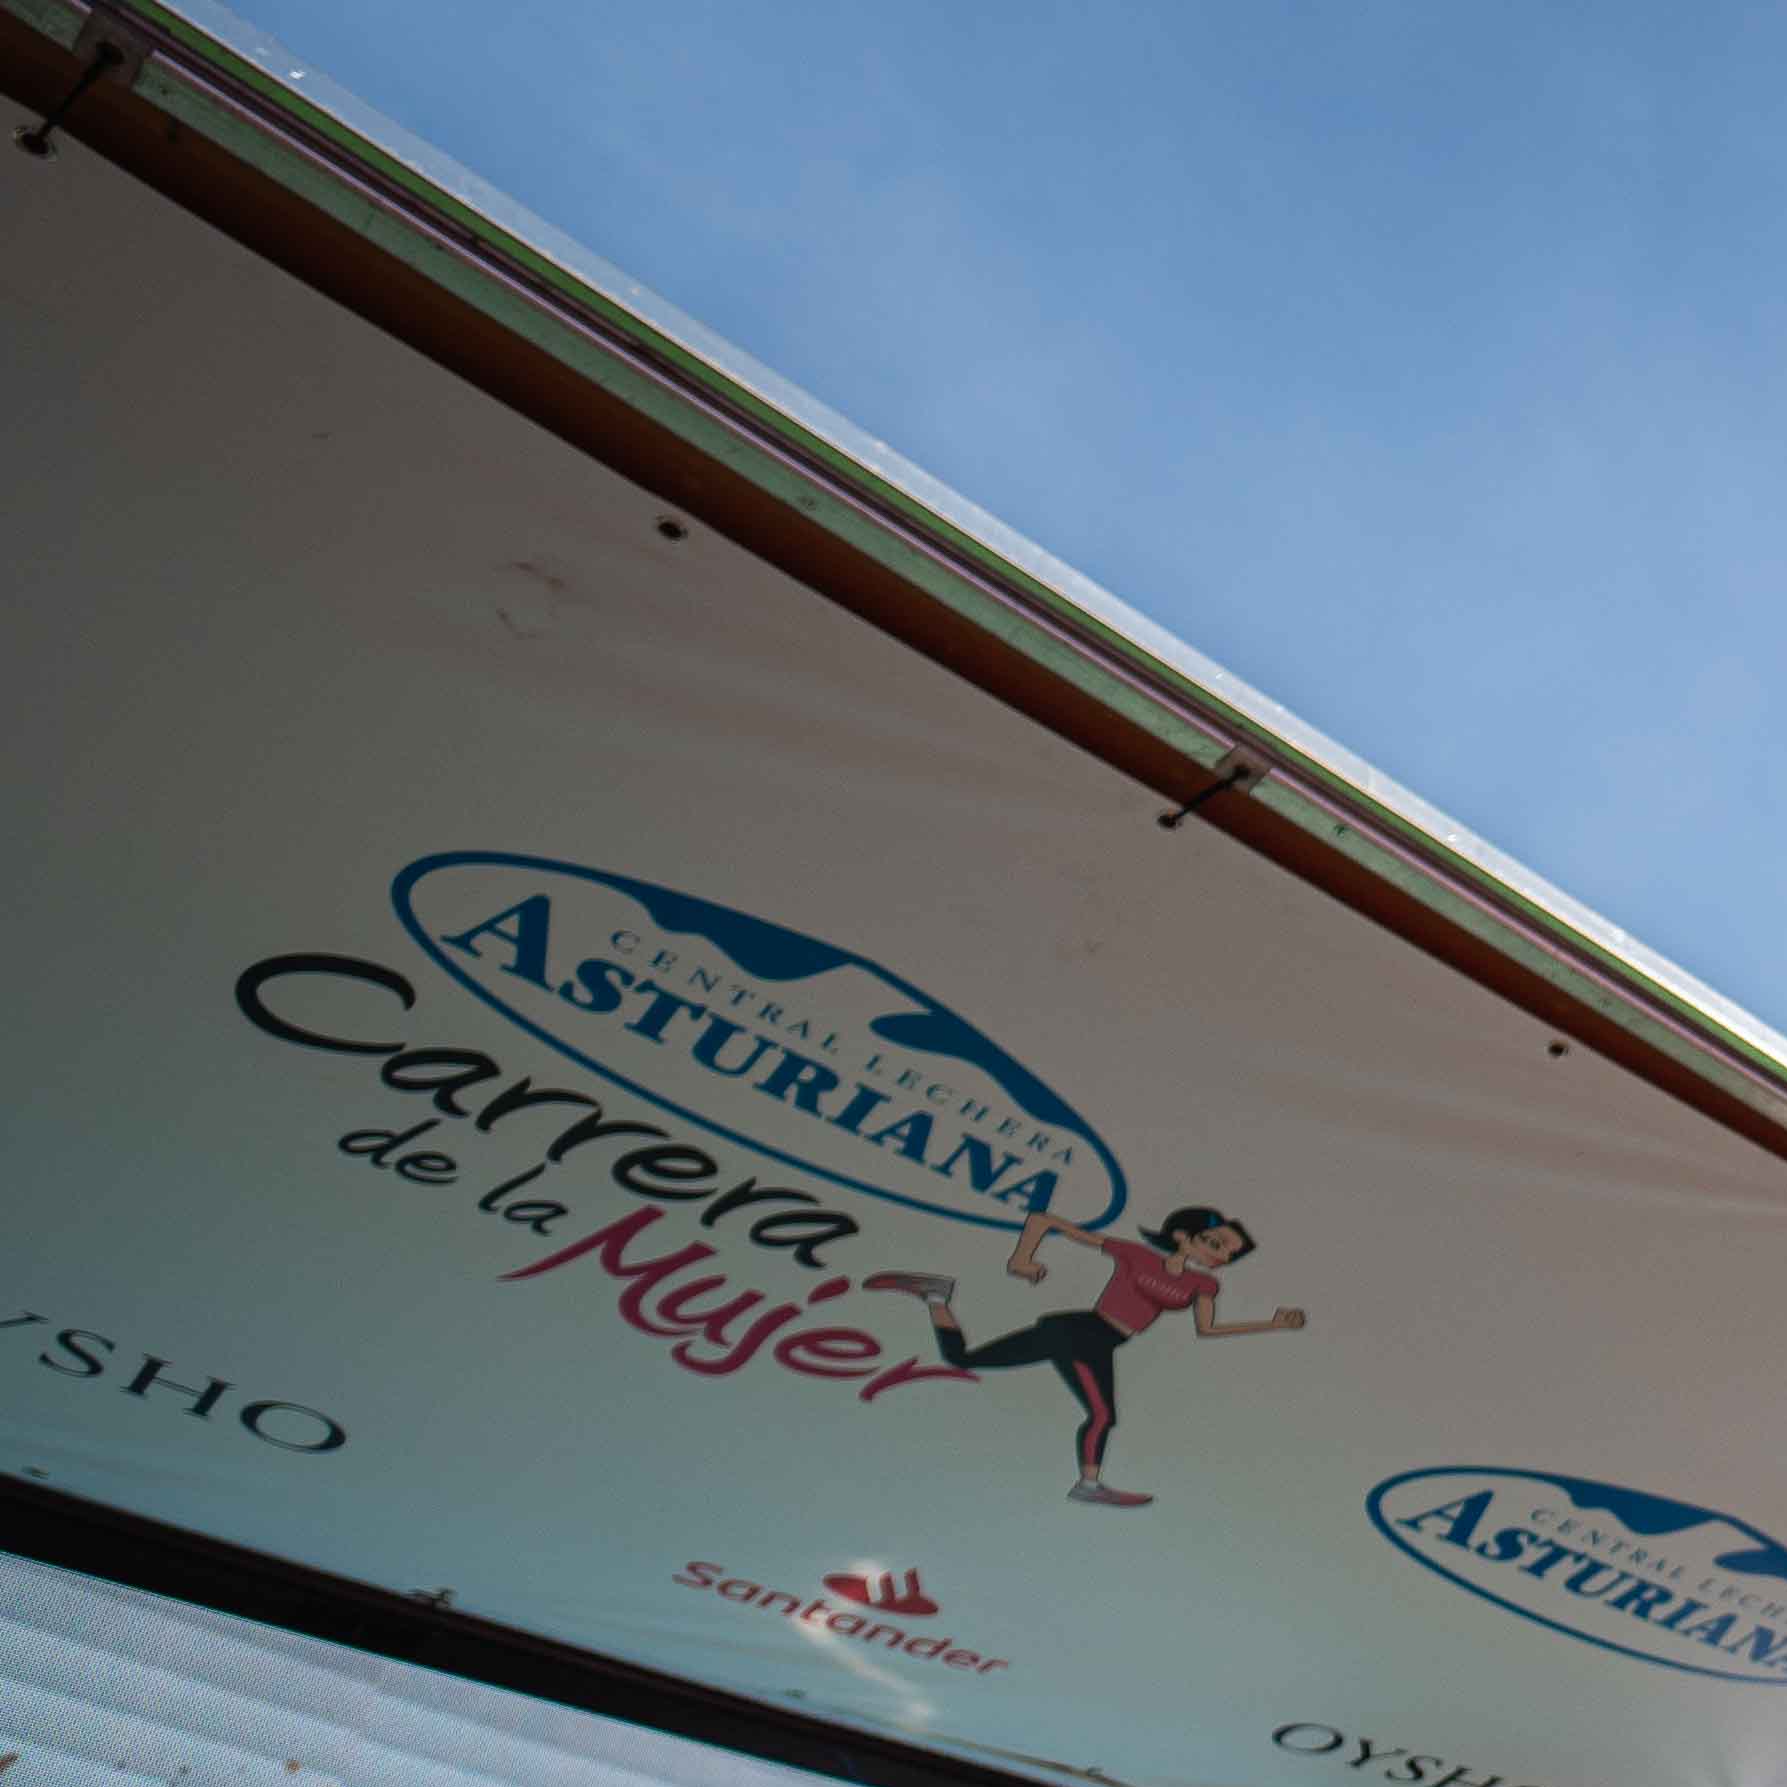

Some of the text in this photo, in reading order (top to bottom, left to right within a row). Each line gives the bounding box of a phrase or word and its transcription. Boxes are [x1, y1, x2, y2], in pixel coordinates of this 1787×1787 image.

[234, 952, 861, 1270] Carrera
[441, 893, 1062, 1216] ASTURIANA
[611, 927, 1077, 1164] CENTRAL LECHERA
[336, 1117, 571, 1238] de la
[0, 1310, 347, 1453] SHO
[496, 1204, 982, 1403] Mujer
[671, 1559, 1010, 1674] Santander
[1529, 1506, 1687, 1581] CENTRAL
